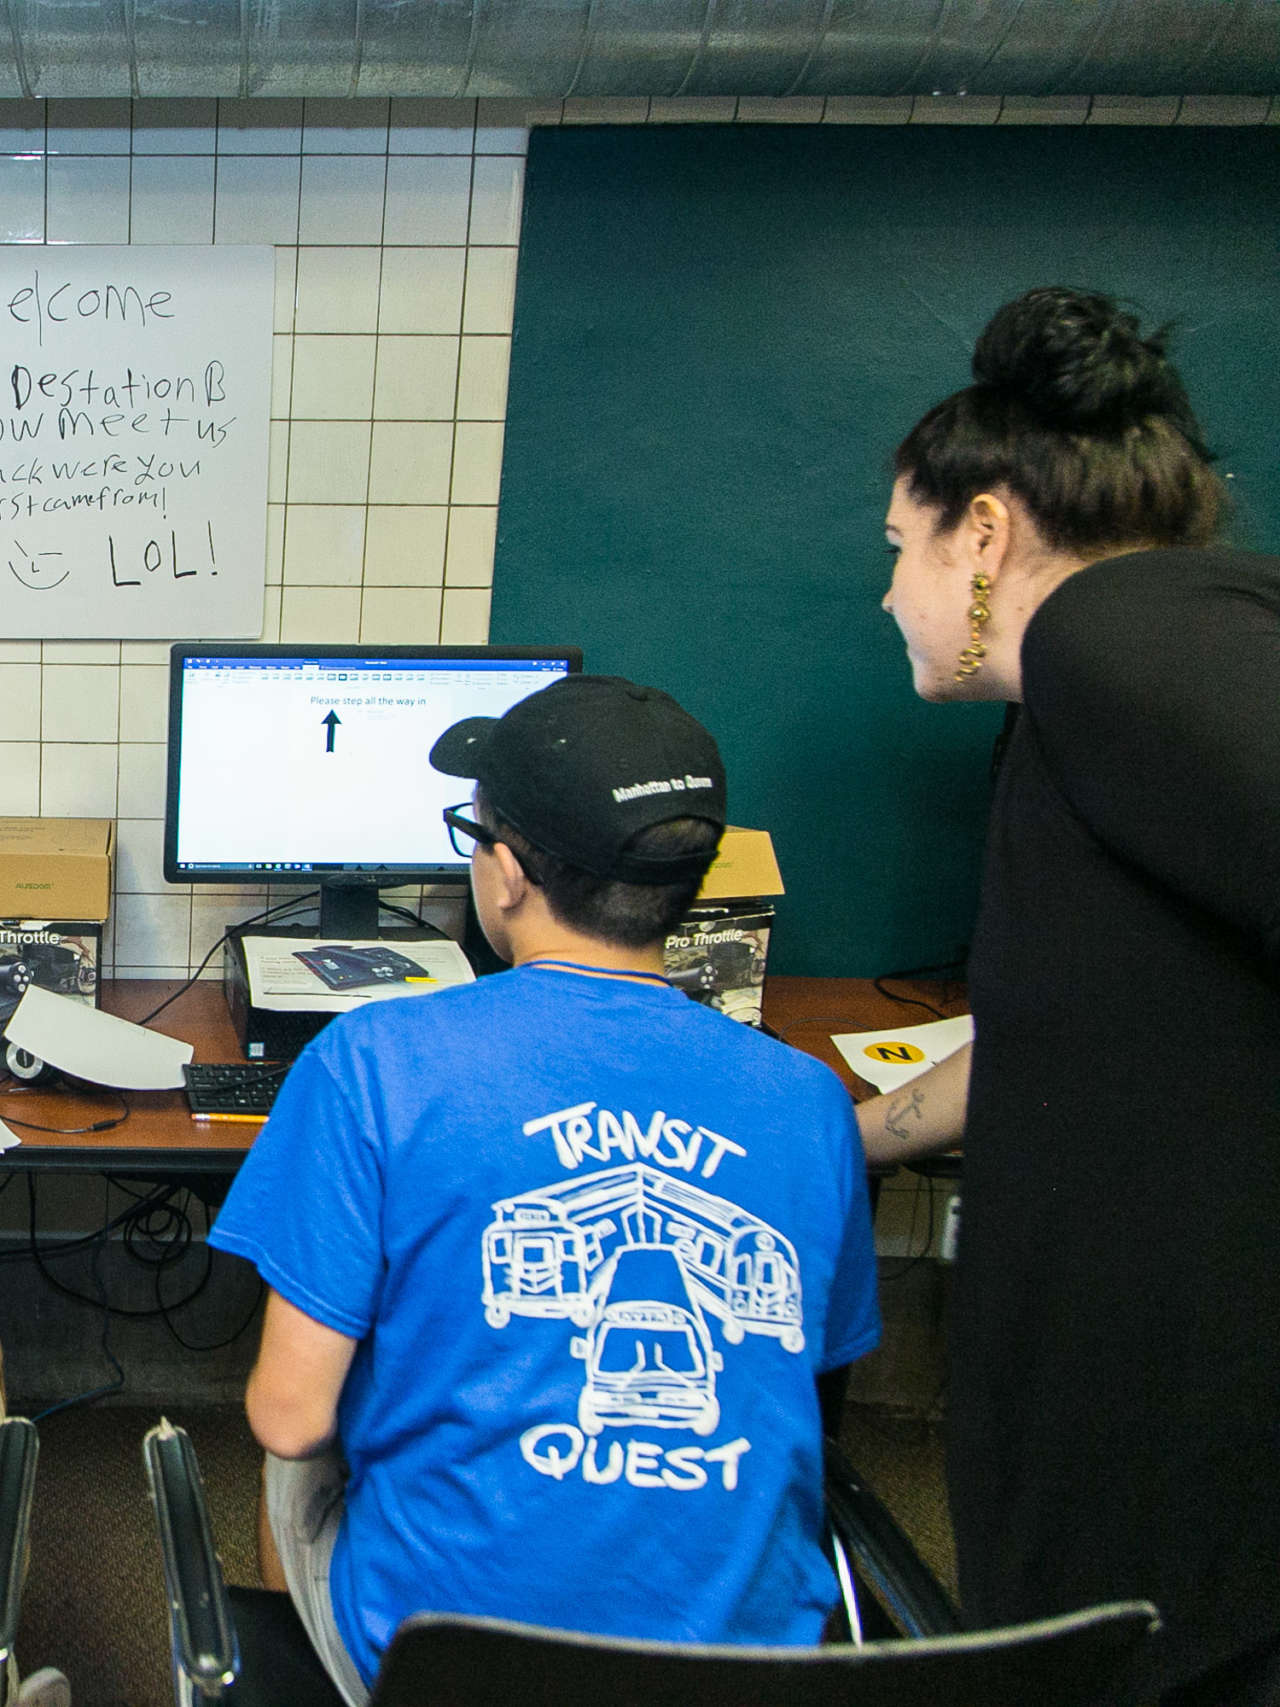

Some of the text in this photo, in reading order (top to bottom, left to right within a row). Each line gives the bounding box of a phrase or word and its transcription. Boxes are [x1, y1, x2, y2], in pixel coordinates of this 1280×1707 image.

[205, 360, 226, 408] B
[198, 417, 237, 449] us
[310, 696, 426, 707] Please step all the way in
[665, 929, 745, 949] Pro Throttle
[523, 1101, 747, 1178] TRANSIT
[520, 1424, 751, 1492] QUEST
